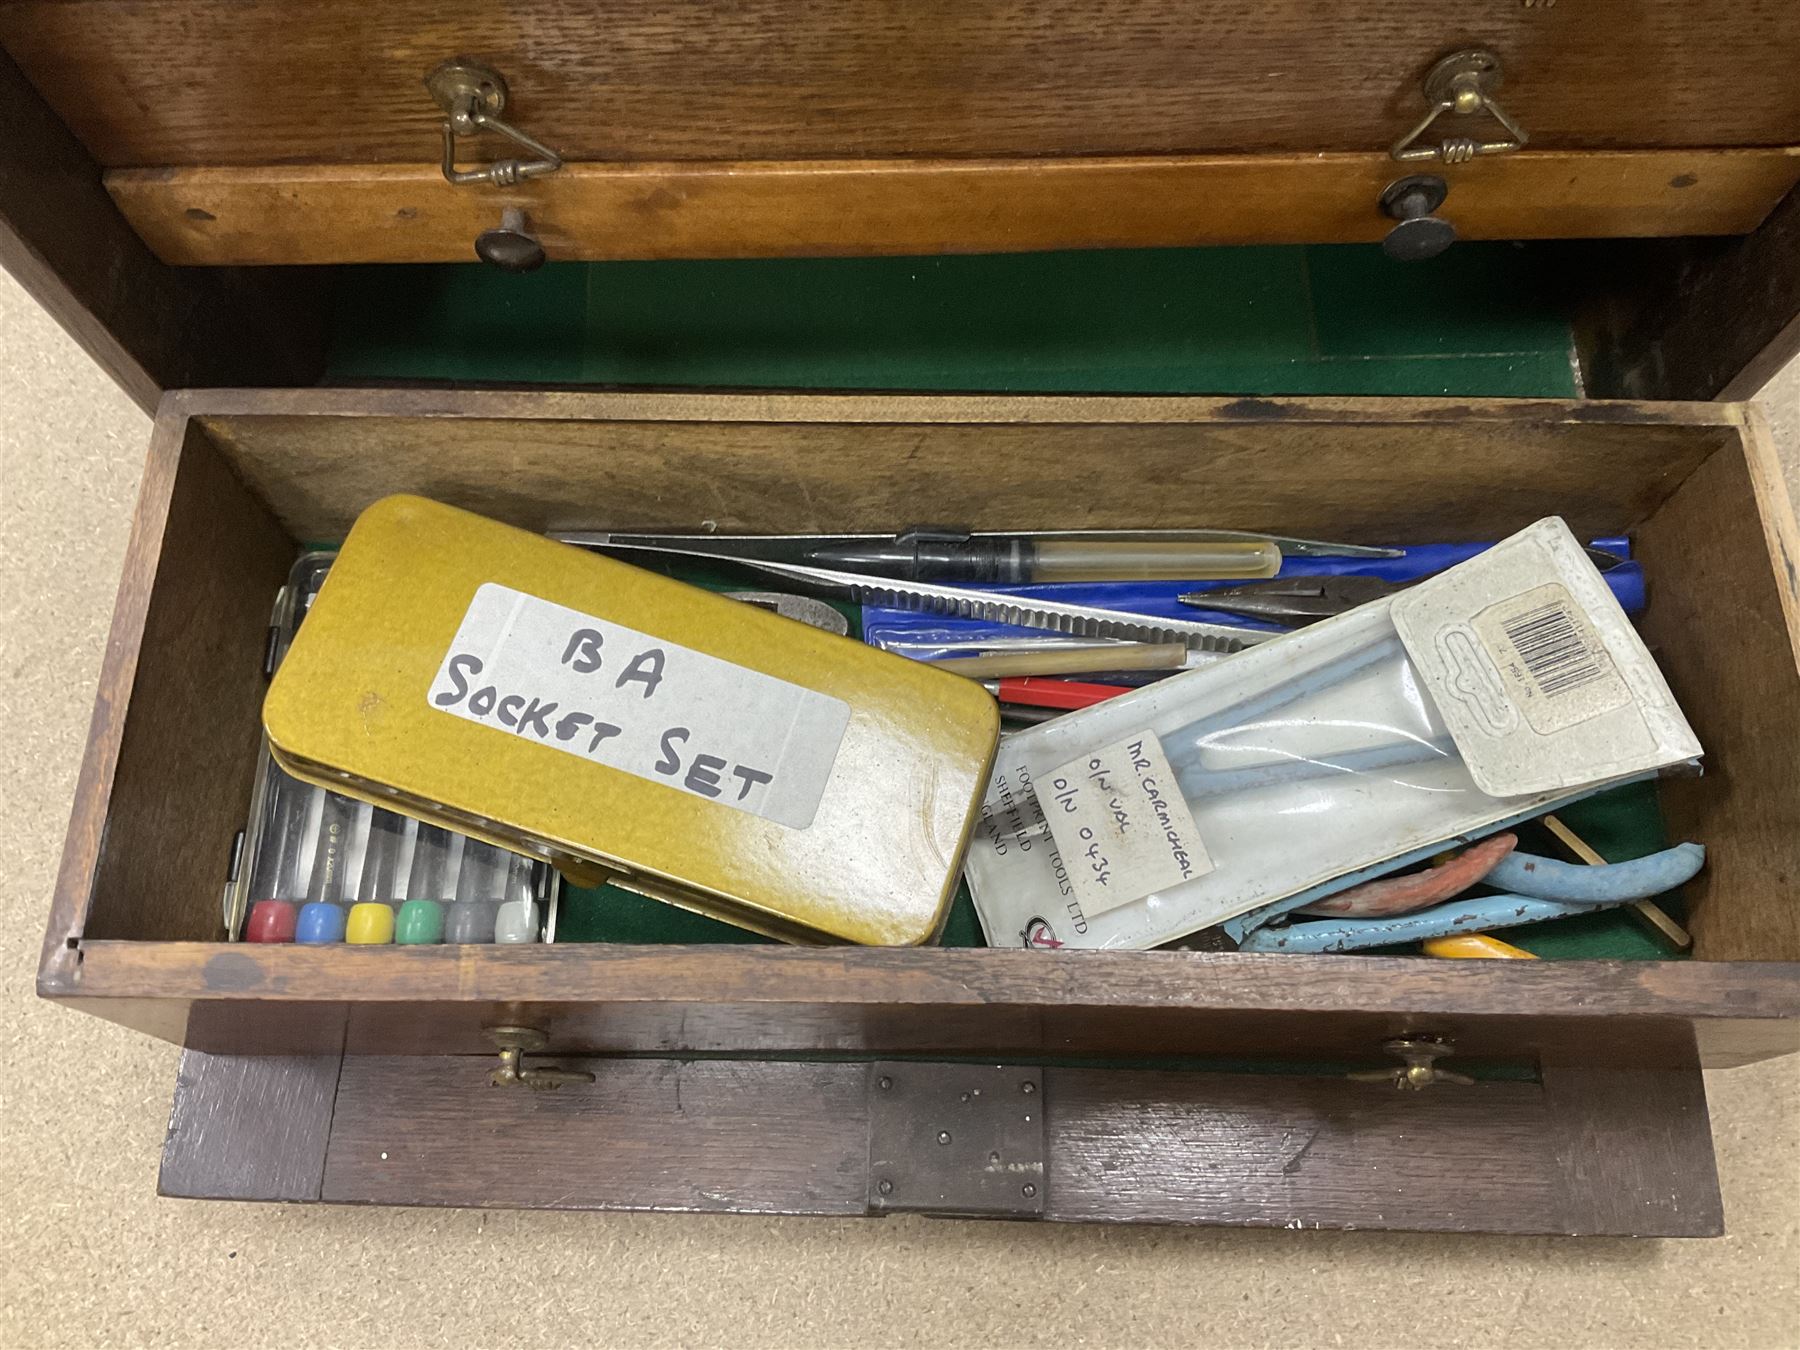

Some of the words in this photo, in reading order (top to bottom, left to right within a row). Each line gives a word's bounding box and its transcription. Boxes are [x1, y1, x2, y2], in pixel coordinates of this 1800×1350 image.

[435, 653, 623, 753] SOCKET
[654, 727, 774, 801] SET
[980, 802, 1008, 856] GLAND
[995, 776, 1032, 852] SHEFFIELD
[1067, 902, 1088, 935] LTD
